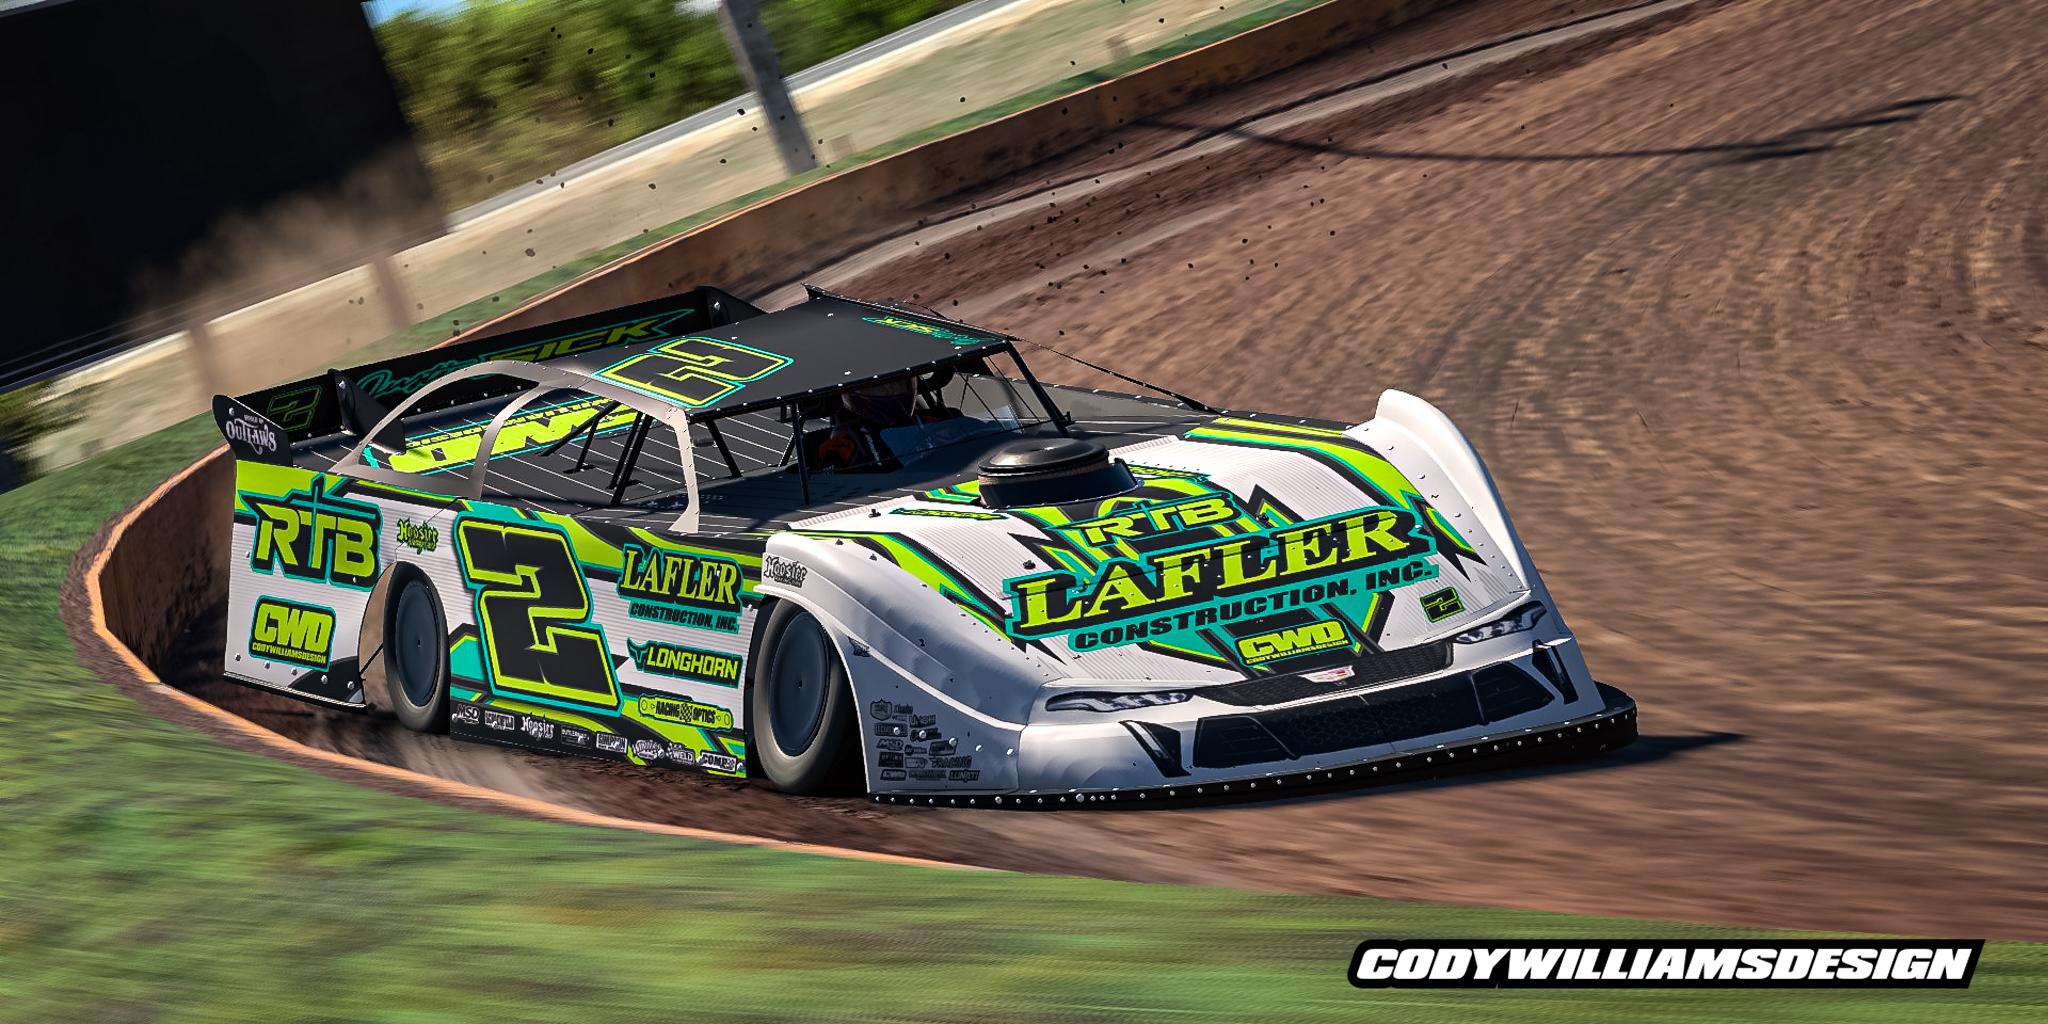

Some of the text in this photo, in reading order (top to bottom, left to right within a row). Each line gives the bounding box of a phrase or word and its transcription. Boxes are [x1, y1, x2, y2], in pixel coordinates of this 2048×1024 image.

[255, 497, 376, 577] RTB
[1068, 497, 1233, 544] RTB
[620, 549, 737, 605] LAFLER
[1020, 511, 1413, 628] LAFLER
[457, 518, 620, 708] 2
[630, 602, 738, 631] CONSTRUCTION, INC.
[1074, 560, 1433, 647] CONSTRUCTION, INC.
[1421, 587, 1465, 623] 2
[254, 605, 334, 655] CWD
[1238, 620, 1347, 659] CWD
[646, 647, 739, 680] LONGHORN
[655, 700, 716, 724] RACING OPTICS
